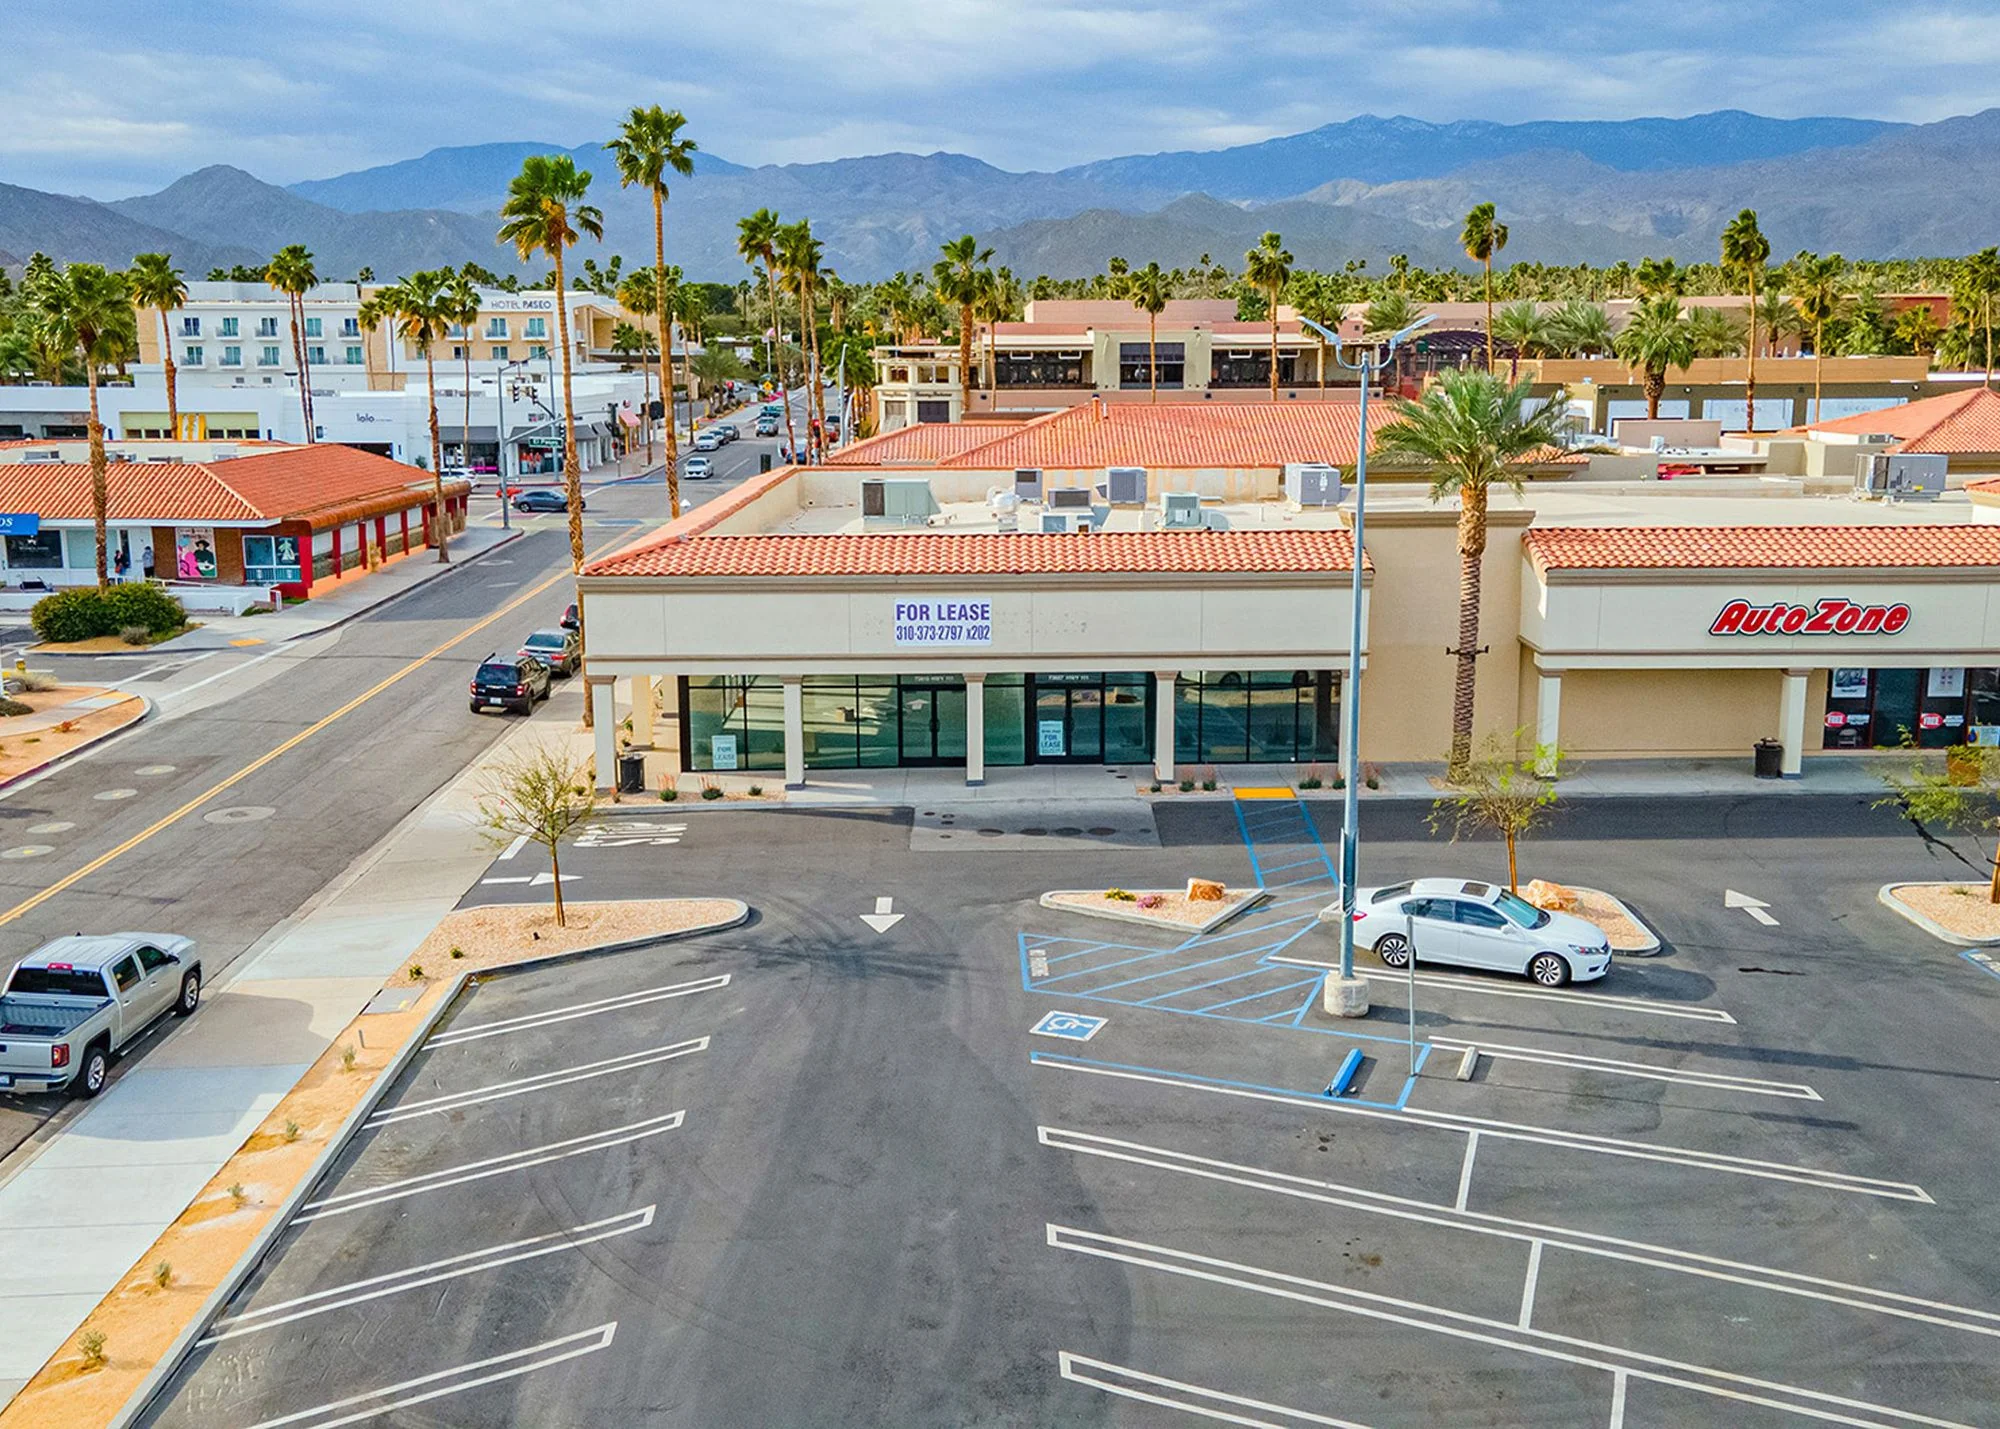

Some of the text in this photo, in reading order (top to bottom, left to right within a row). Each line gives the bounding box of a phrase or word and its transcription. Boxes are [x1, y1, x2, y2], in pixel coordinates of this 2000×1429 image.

[491, 300, 552, 309] HOTEL PASEO
[896, 604, 990, 621] FOR LEASE
[1709, 599, 1911, 635] AutoZone
[896, 625, 990, 641] 310-373-2797 x202
